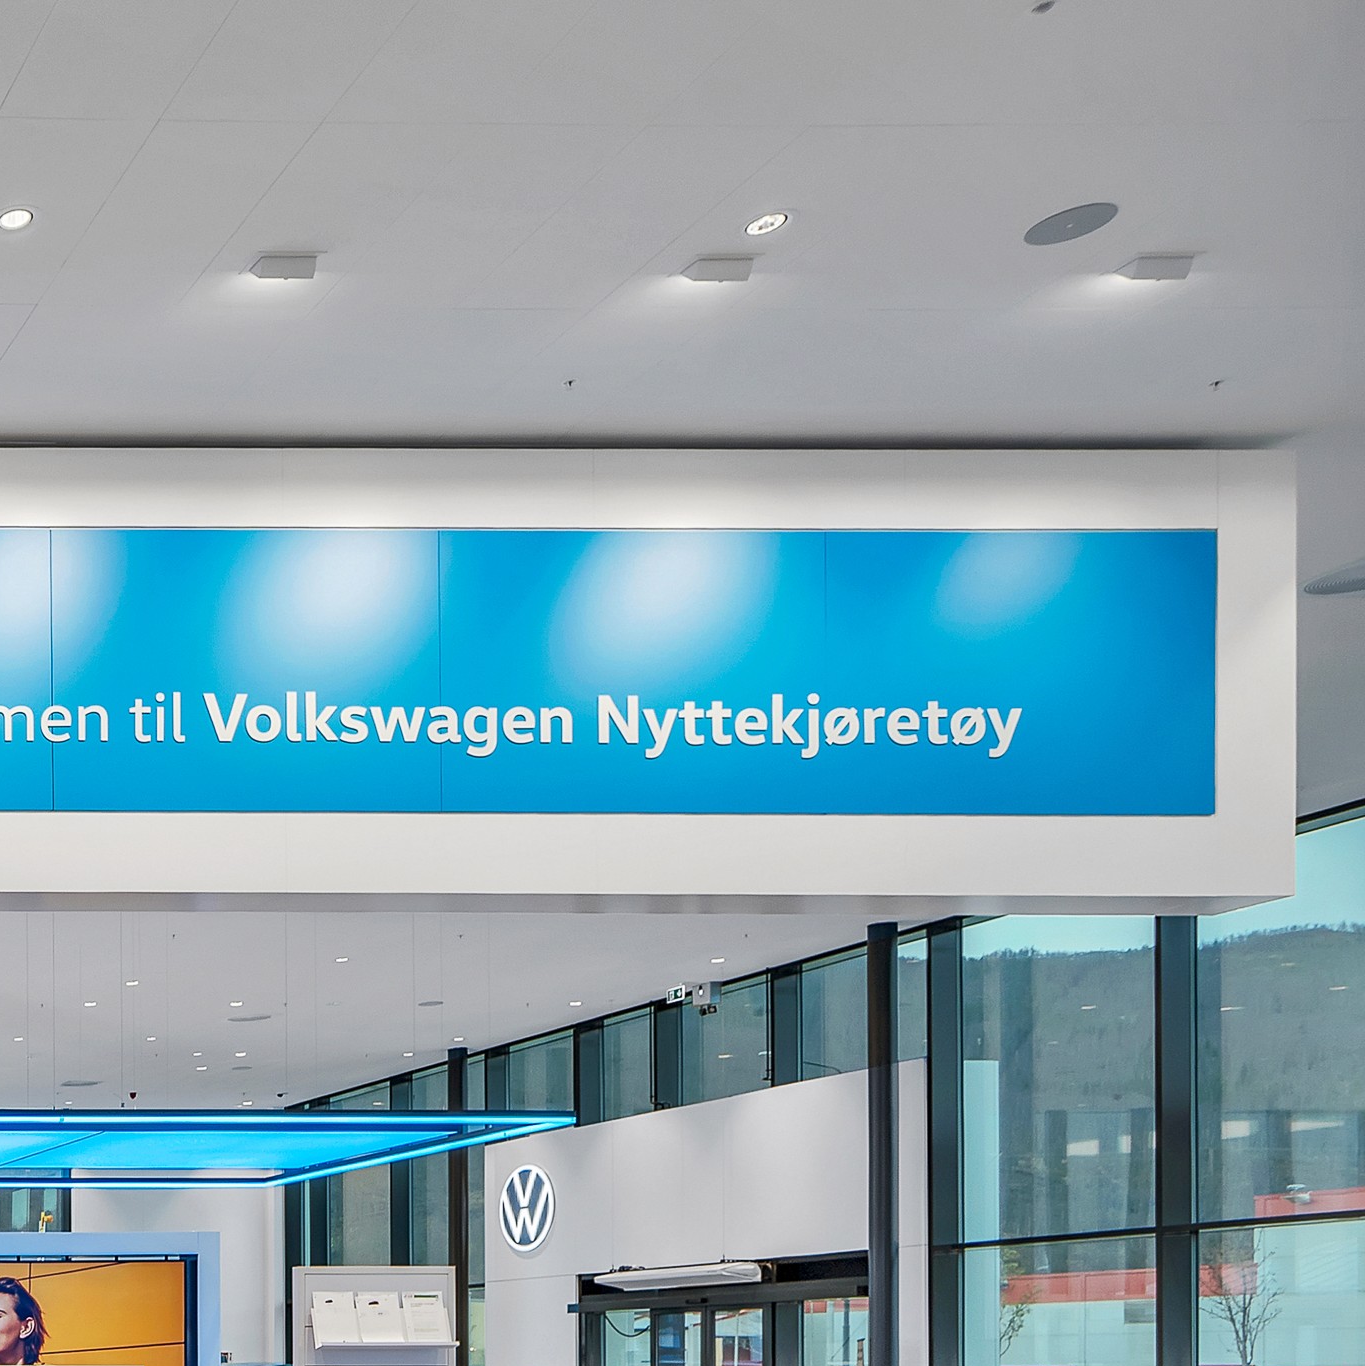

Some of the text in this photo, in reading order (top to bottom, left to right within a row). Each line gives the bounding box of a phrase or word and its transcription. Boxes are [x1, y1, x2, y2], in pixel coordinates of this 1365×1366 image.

[129, 691, 186, 742] til
[203, 690, 573, 757] Volkswagen
[598, 693, 1022, 759] Nyttekjøretøy
